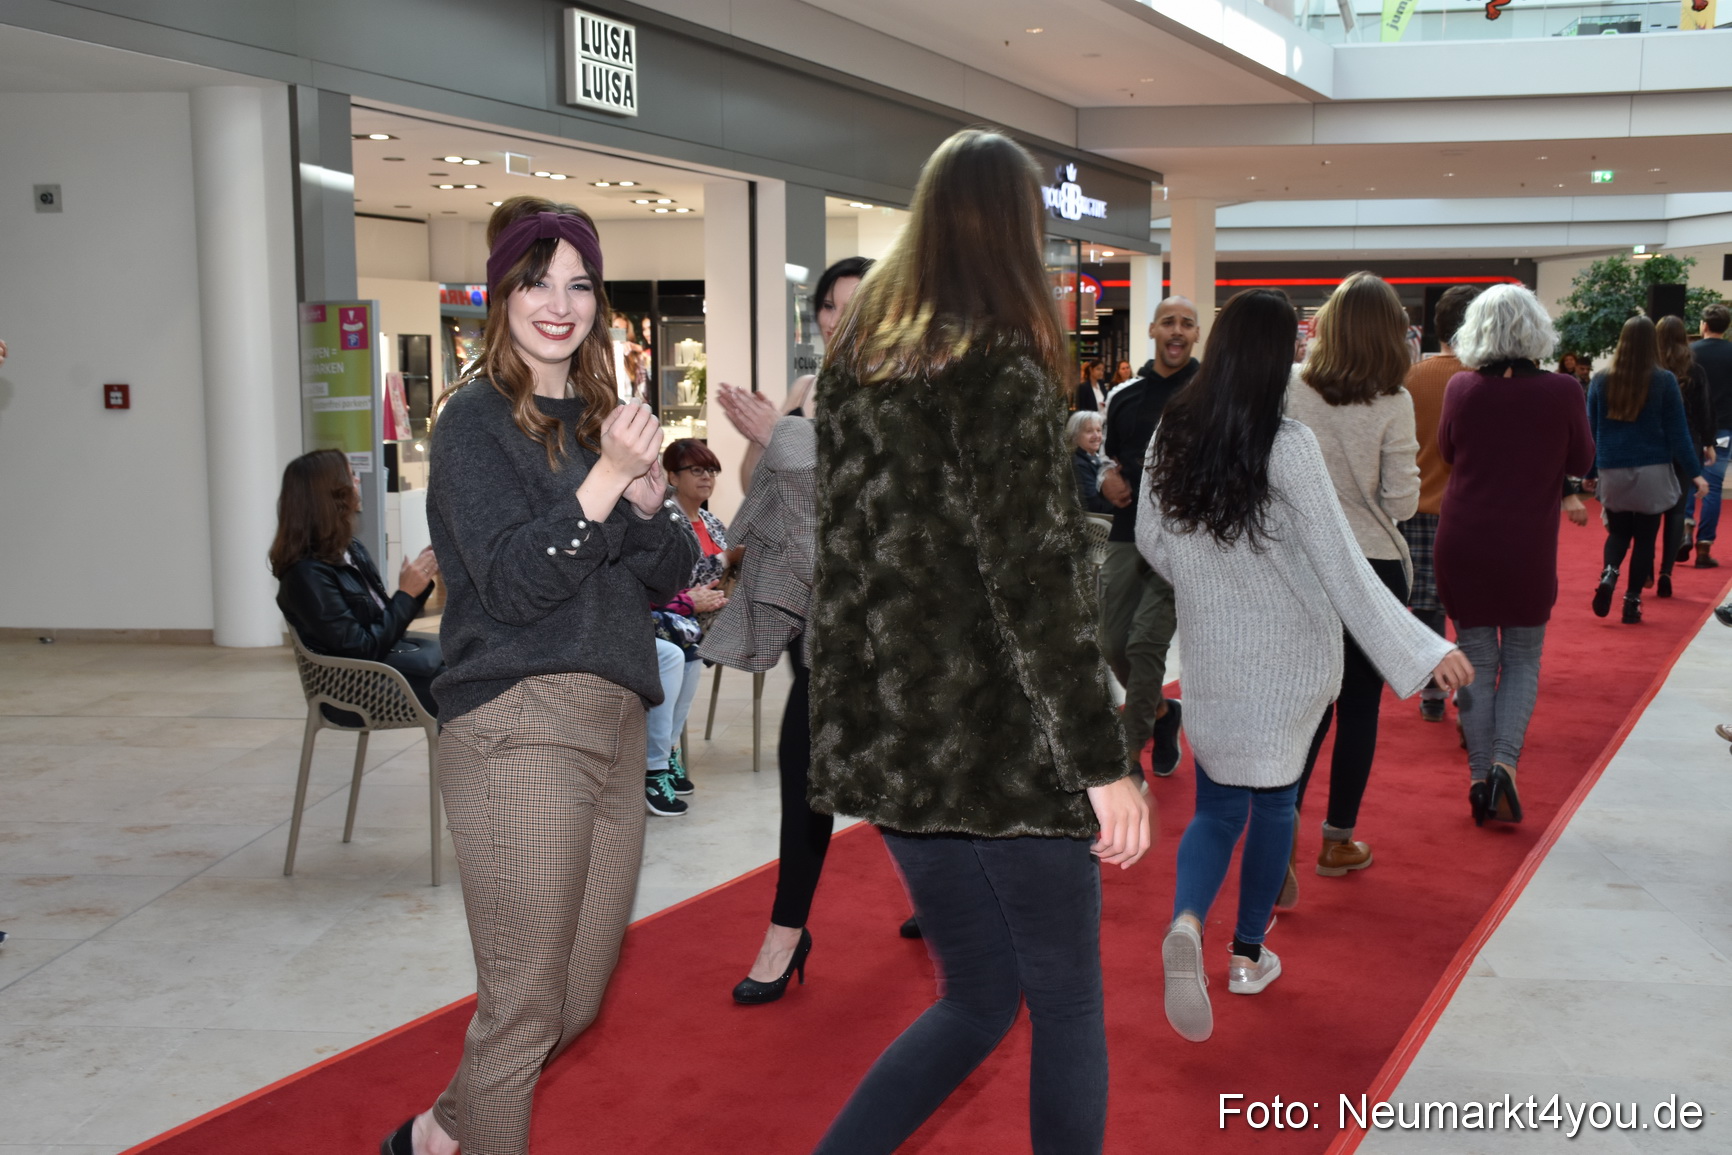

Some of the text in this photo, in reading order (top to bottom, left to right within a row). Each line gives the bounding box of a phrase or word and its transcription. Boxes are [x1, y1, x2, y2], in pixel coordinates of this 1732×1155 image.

[1386, 0, 1412, 31] jum
[580, 16, 634, 65] LUISA
[581, 63, 635, 109] LUISA
